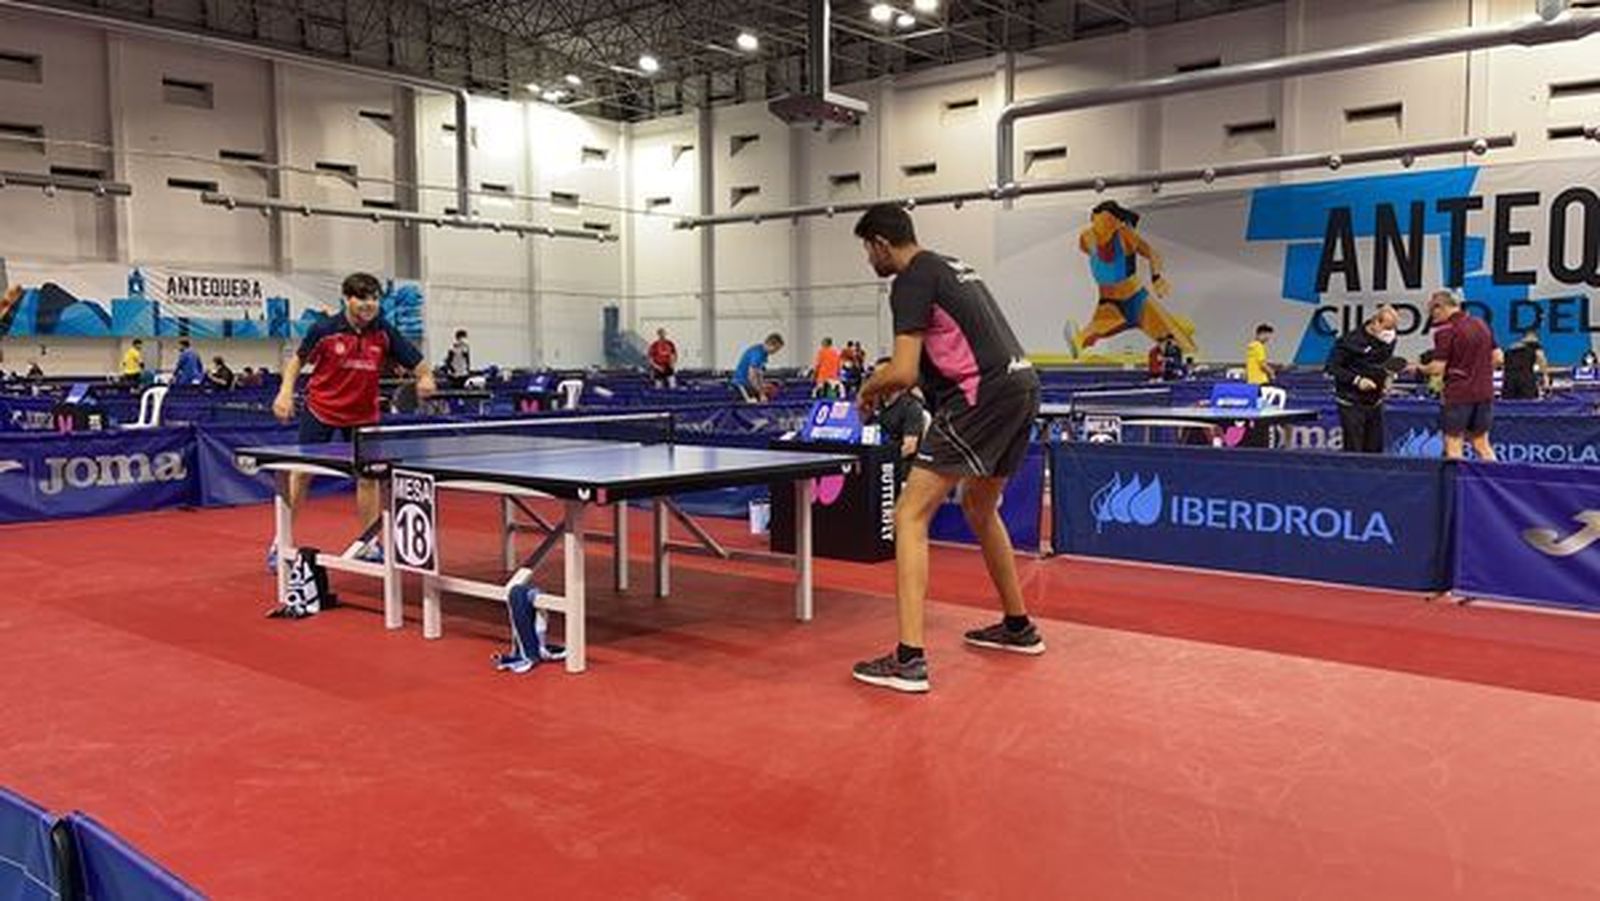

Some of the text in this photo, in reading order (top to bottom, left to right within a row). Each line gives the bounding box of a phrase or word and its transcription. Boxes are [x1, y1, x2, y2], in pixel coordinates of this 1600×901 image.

[1314, 187, 1600, 293] ANTEQ
[167, 276, 263, 299] ANTEQUERA
[1509, 297, 1600, 334] DEL
[394, 475, 434, 505] MESA
[397, 510, 428, 562] 18
[1170, 495, 1395, 545] IBERDROLA
